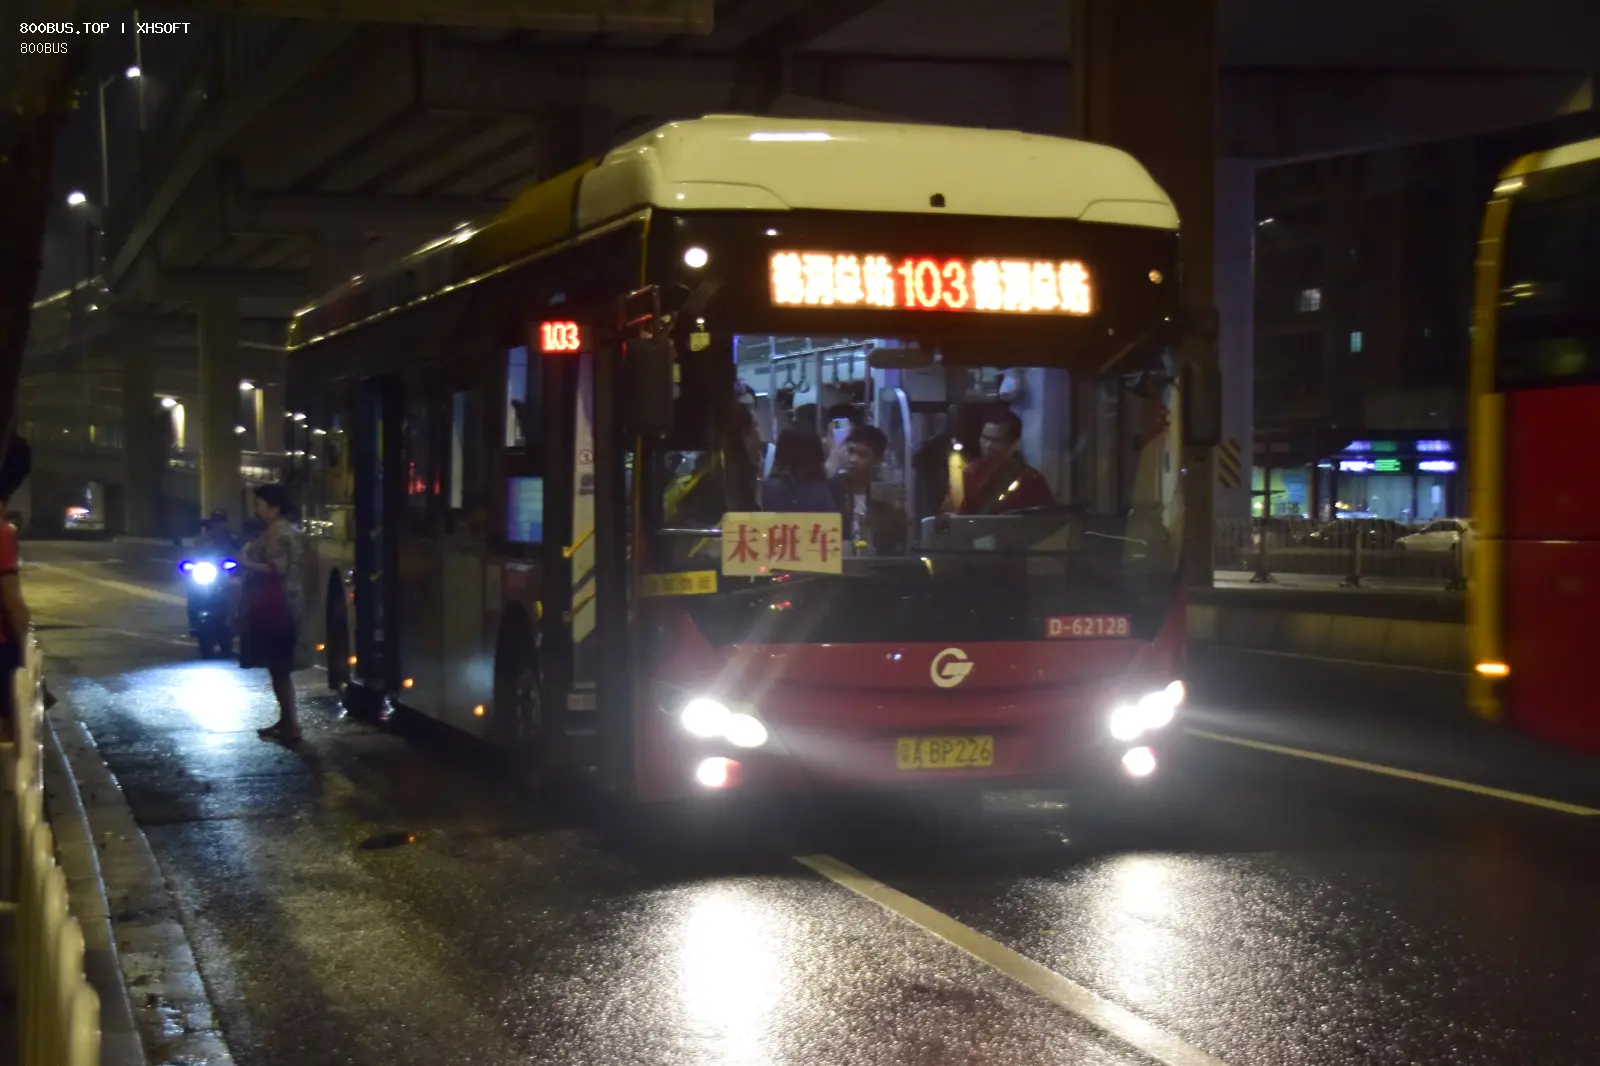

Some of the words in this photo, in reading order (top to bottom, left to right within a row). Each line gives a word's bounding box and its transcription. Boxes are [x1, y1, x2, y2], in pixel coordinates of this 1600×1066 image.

[898, 258, 969, 309] 103
[540, 320, 580, 352] 103
[726, 523, 841, 564] 末班车
[1048, 617, 1128, 636] D-62128
